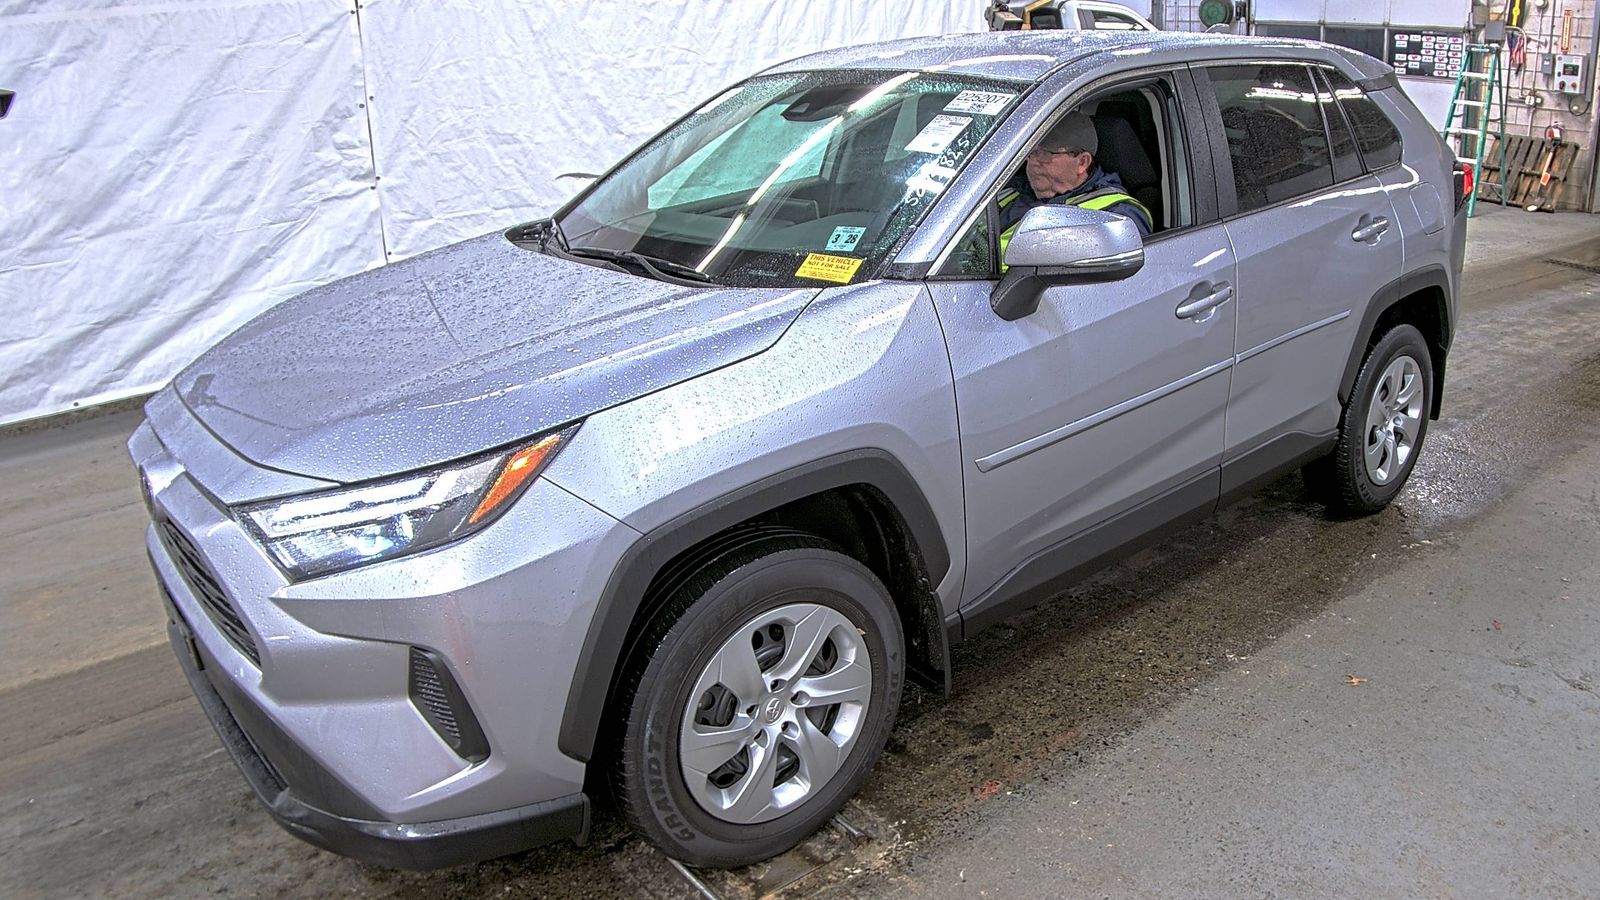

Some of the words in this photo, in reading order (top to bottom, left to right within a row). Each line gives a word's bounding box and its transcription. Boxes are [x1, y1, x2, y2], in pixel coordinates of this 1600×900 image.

[956, 92, 1010, 105] 2252071
[831, 233, 841, 244] 3
[844, 233, 859, 244] 28
[809, 254, 826, 262] THIS
[827, 256, 858, 266] VEHICLE
